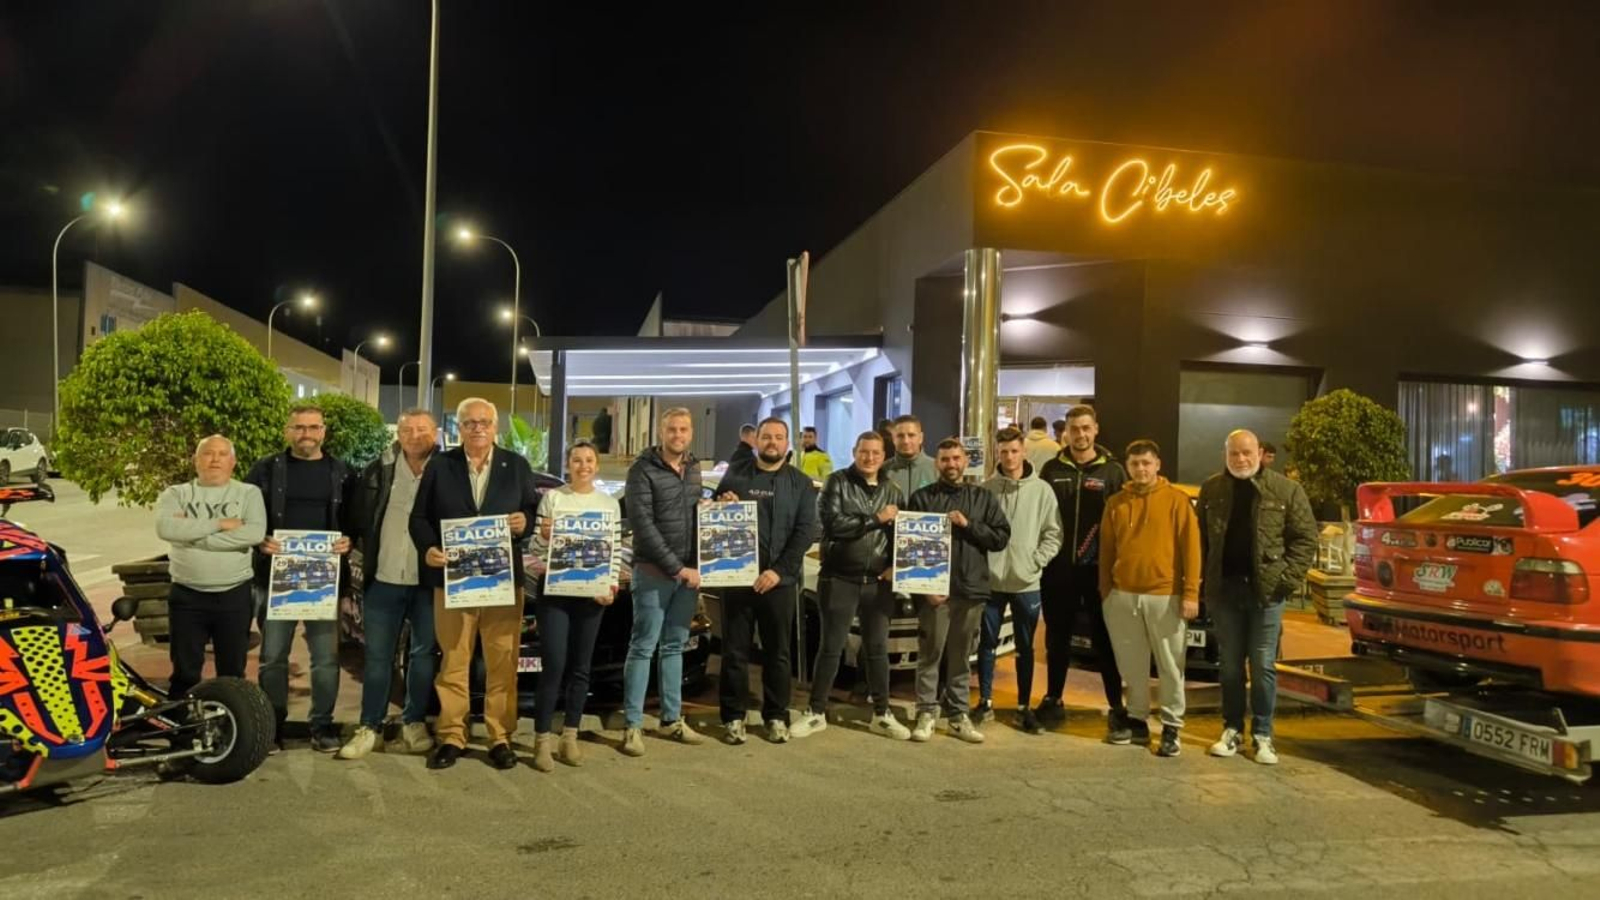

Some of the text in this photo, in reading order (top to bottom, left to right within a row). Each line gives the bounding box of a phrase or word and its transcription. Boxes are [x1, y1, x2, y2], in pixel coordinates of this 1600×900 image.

[989, 144, 1237, 223] Sala Cibeles
[184, 502, 239, 519] NYC
[700, 512, 756, 523] SLALOM
[555, 520, 612, 531] SLALOM
[445, 527, 508, 542] SLALOM
[1394, 620, 1505, 652] Motorsport
[1473, 721, 1550, 759] 0552 FRM
